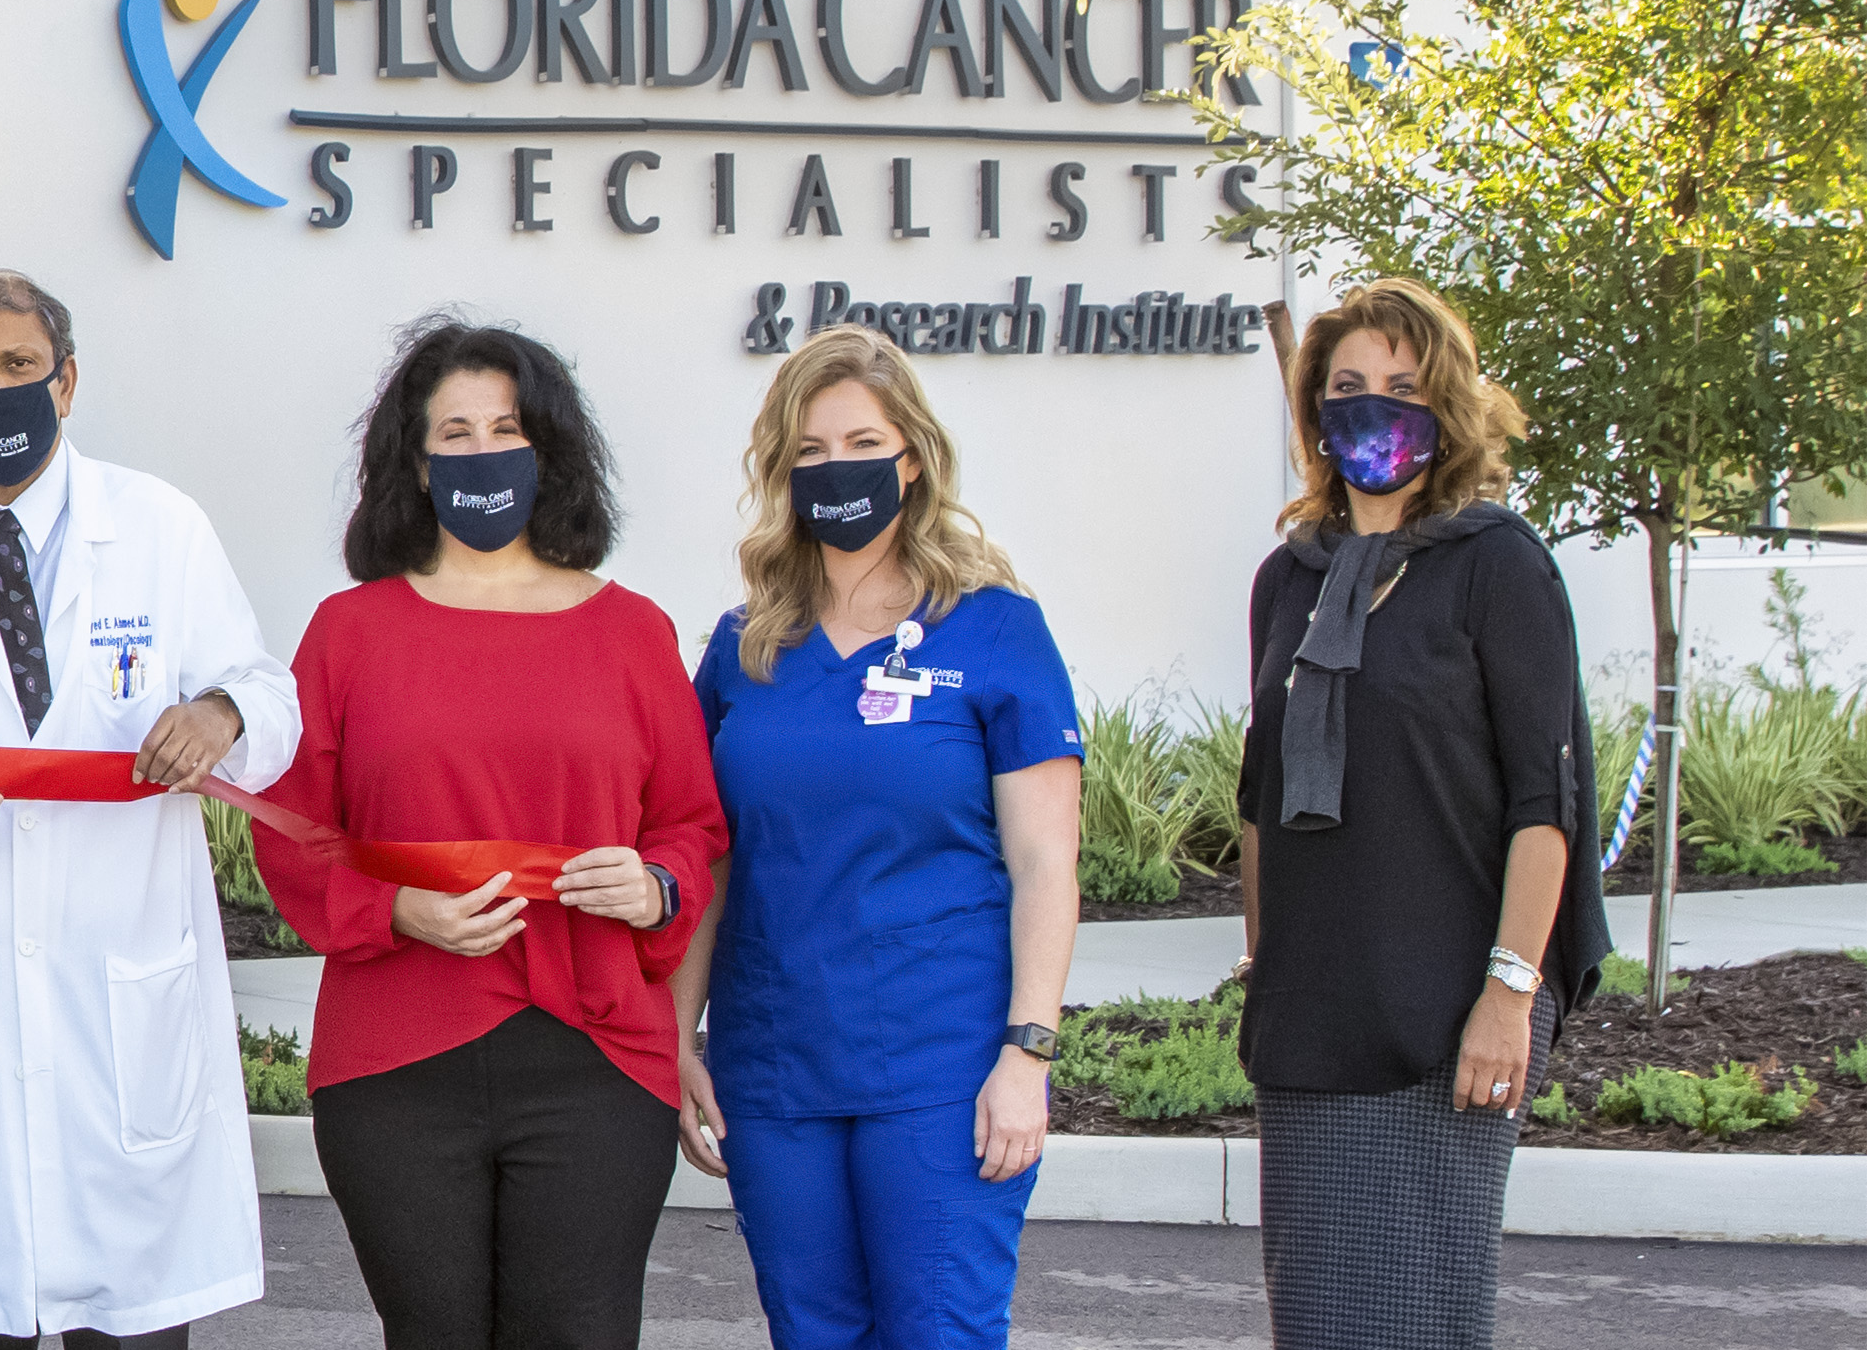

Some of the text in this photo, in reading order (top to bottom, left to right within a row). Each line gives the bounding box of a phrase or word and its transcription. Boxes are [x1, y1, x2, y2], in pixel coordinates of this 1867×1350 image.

[308, 139, 1260, 246] SPECIALISTS
[745, 281, 794, 354] &
[1061, 282, 1264, 354] Institute
